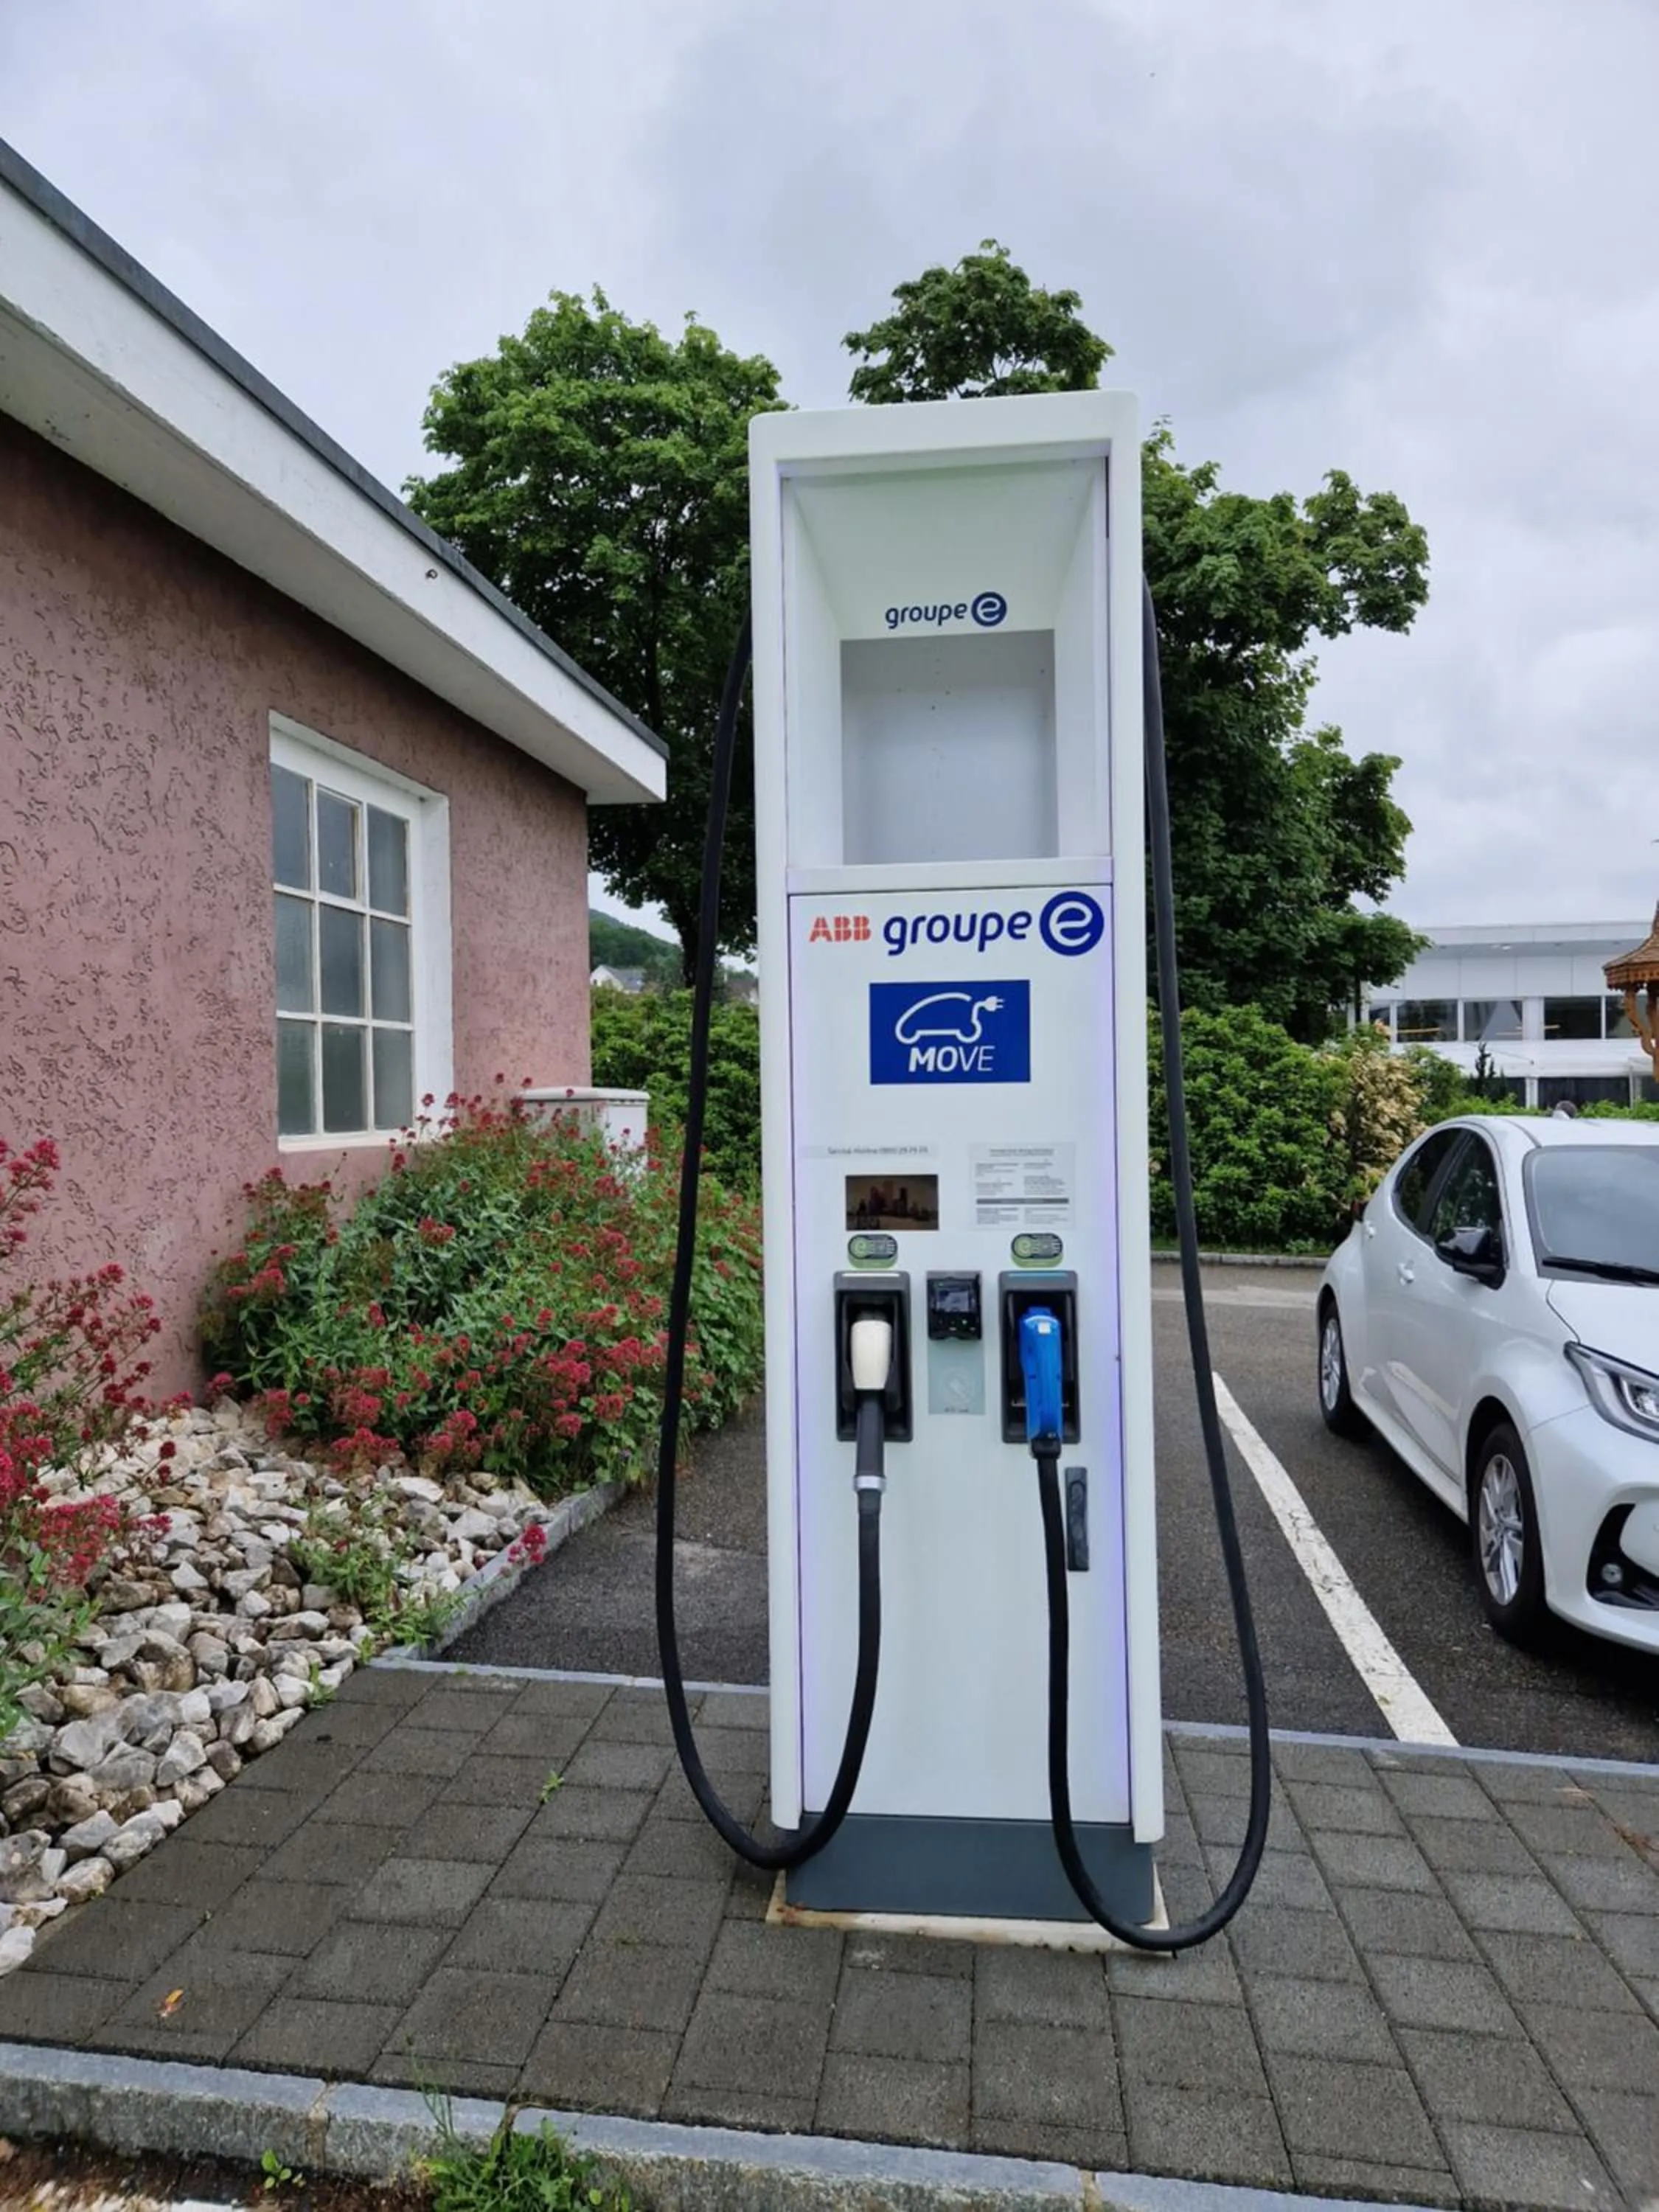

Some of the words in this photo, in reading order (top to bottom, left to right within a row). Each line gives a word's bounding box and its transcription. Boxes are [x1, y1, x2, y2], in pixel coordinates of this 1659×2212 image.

[885, 603, 968, 630] groupe
[810, 915, 871, 942] ABB
[883, 911, 1032, 956] groupe
[909, 1046, 993, 1071] MOVE
